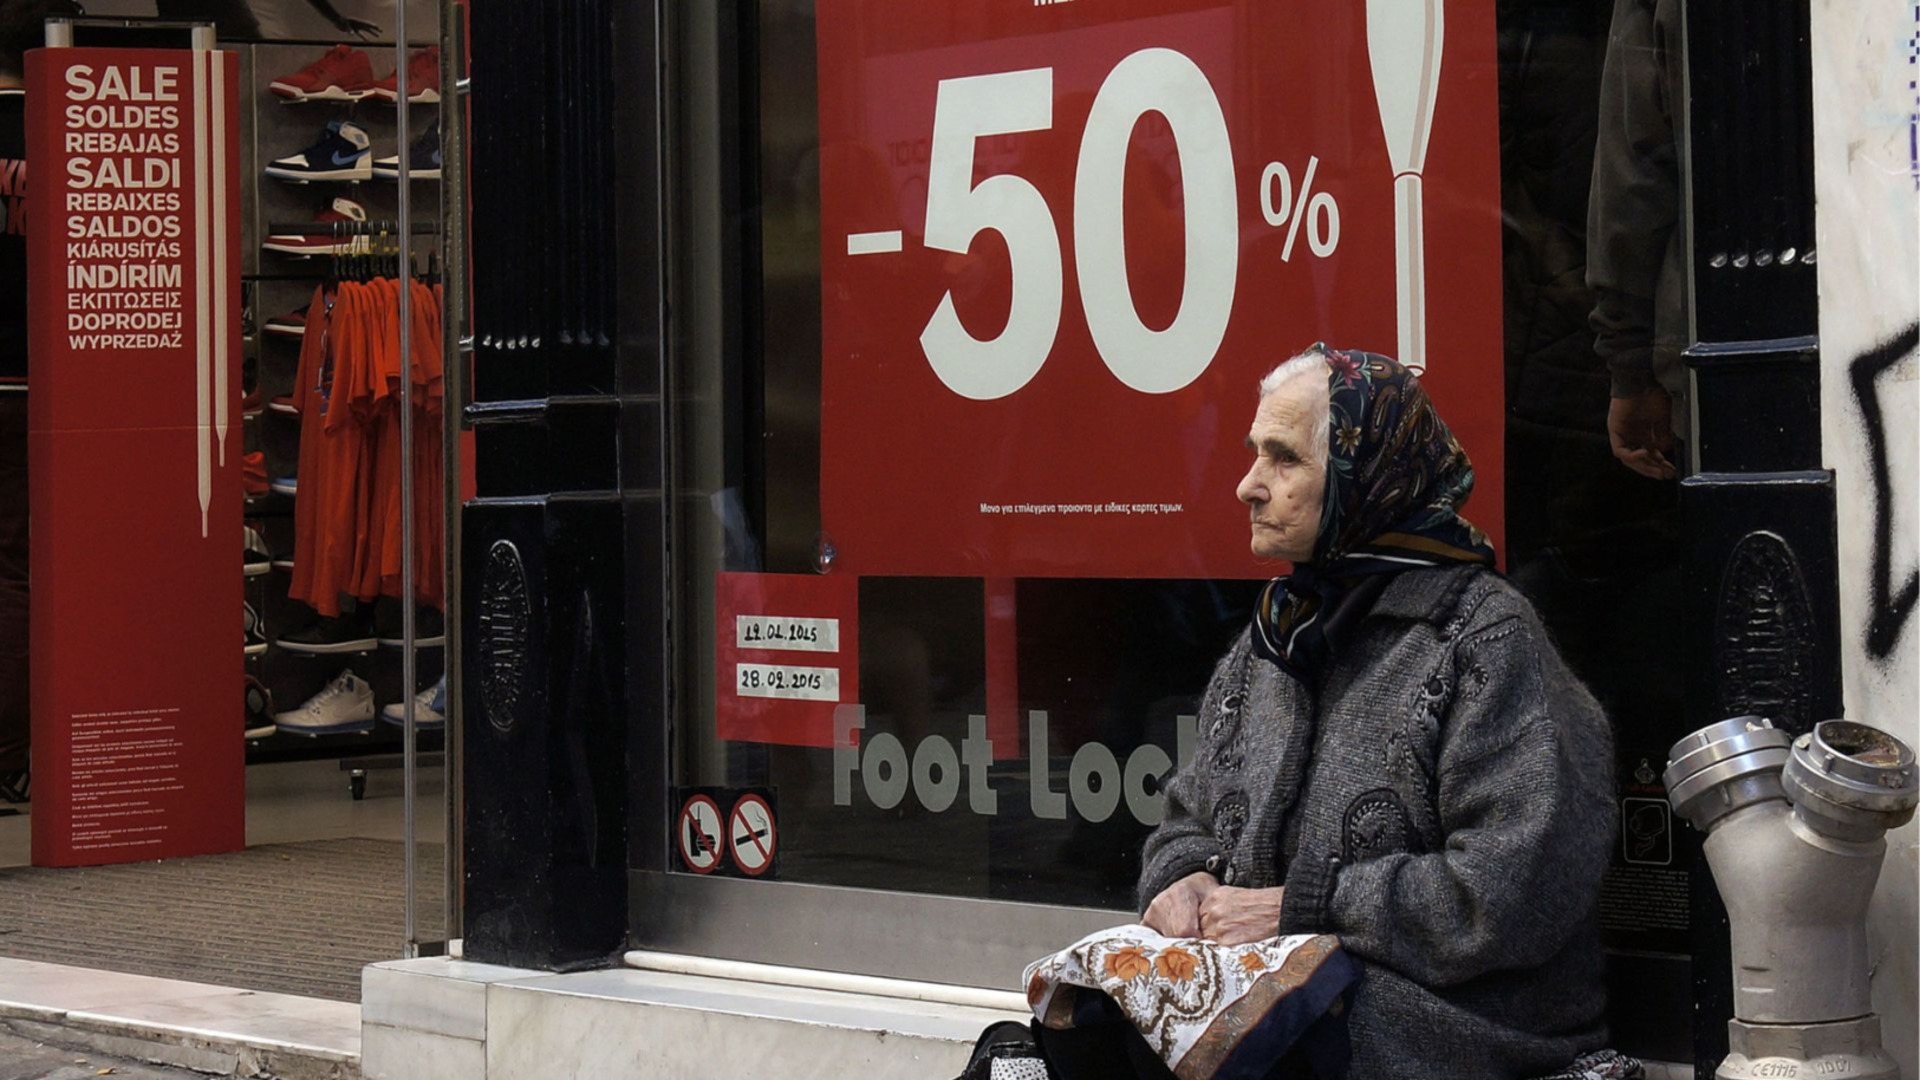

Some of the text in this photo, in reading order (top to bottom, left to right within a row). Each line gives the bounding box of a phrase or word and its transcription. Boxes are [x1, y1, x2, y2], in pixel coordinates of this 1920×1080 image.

[65, 64, 179, 101] SALE
[65, 105, 180, 129] SOLDES
[65, 132, 180, 154] REBAJAS
[66, 157, 181, 189] SALDI
[66, 193, 181, 212] REBAIXES
[67, 215, 181, 238] SALDOS
[67, 239, 181, 258] KIÁRUSÍTÁS
[67, 259, 182, 289] ÍNDÍRÍM
[68, 291, 182, 310] ΕΚΠΤΩΣΕΙΣ
[68, 312, 182, 331] DOPRODEJ
[68, 330, 182, 350] WYPRZEDAŻ
[980, 502, 1000, 513] Μονο
[1001, 505, 1013, 515] για
[1094, 504, 1103, 515] με
[741, 669, 821, 690] 28.02.2015
